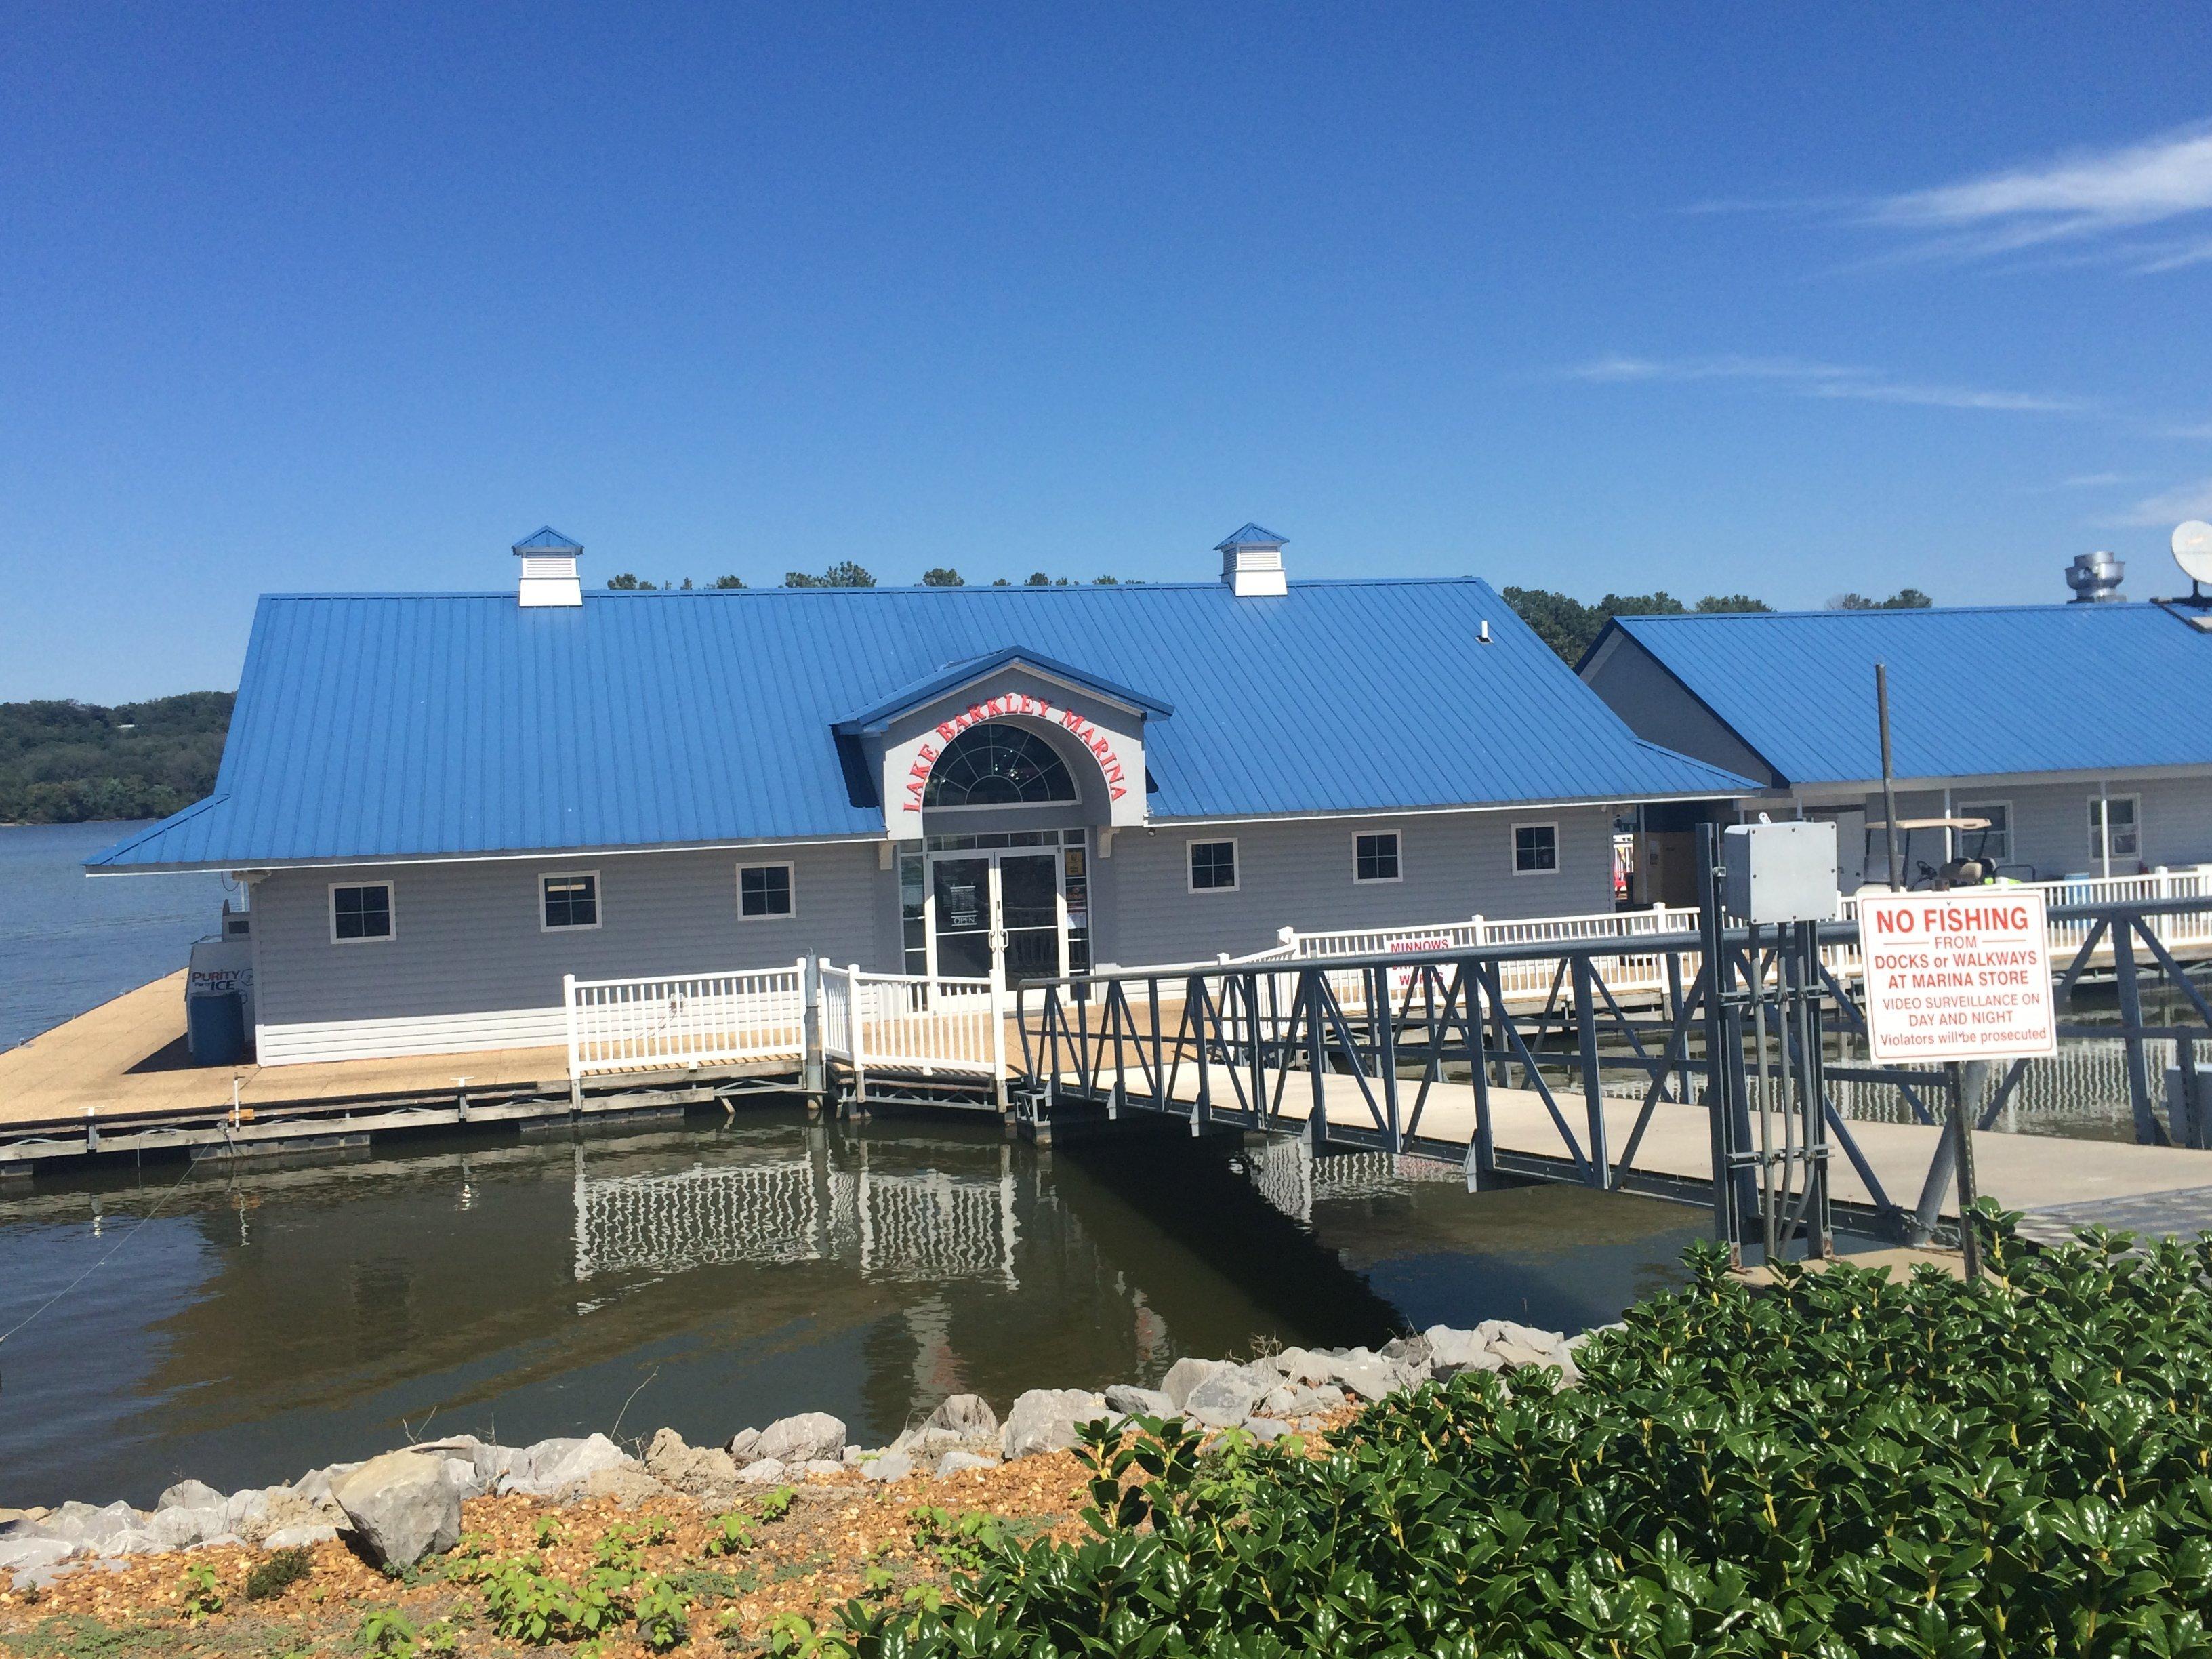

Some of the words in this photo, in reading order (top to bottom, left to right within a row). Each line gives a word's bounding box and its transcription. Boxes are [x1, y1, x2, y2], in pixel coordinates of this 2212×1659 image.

[903, 744, 939, 813] LAKE
[936, 693, 1053, 743] BARKLEY
[1059, 709, 1127, 802] MARINA
[1876, 909, 1914, 933] NO
[1924, 907, 2028, 933] FISHING
[1391, 939, 1449, 953] MINNOWS
[1935, 936, 1978, 949] FROM
[1875, 954, 1929, 970] DOCKS
[1934, 956, 1948, 968] or
[1953, 950, 2037, 967] WALKWAYS
[211, 980, 235, 990] ICE
[1888, 975, 1908, 989] AT
[1912, 972, 1973, 988] MARINA
[1978, 970, 2029, 986] STORE
[1883, 997, 1921, 1010] VIDEO
[1925, 994, 2018, 1009] SURVEILLANCE
[2022, 993, 2040, 1006] ON
[1909, 1013, 1935, 1027] DAY
[1939, 1012, 1967, 1026] AND
[1972, 1010, 2013, 1024] NIGHT
[1880, 1031, 1935, 1046] Violators
[1938, 1031, 1959, 1044] will
[1961, 1031, 1976, 1042] be
[1980, 1027, 2047, 1045] prosecuted
